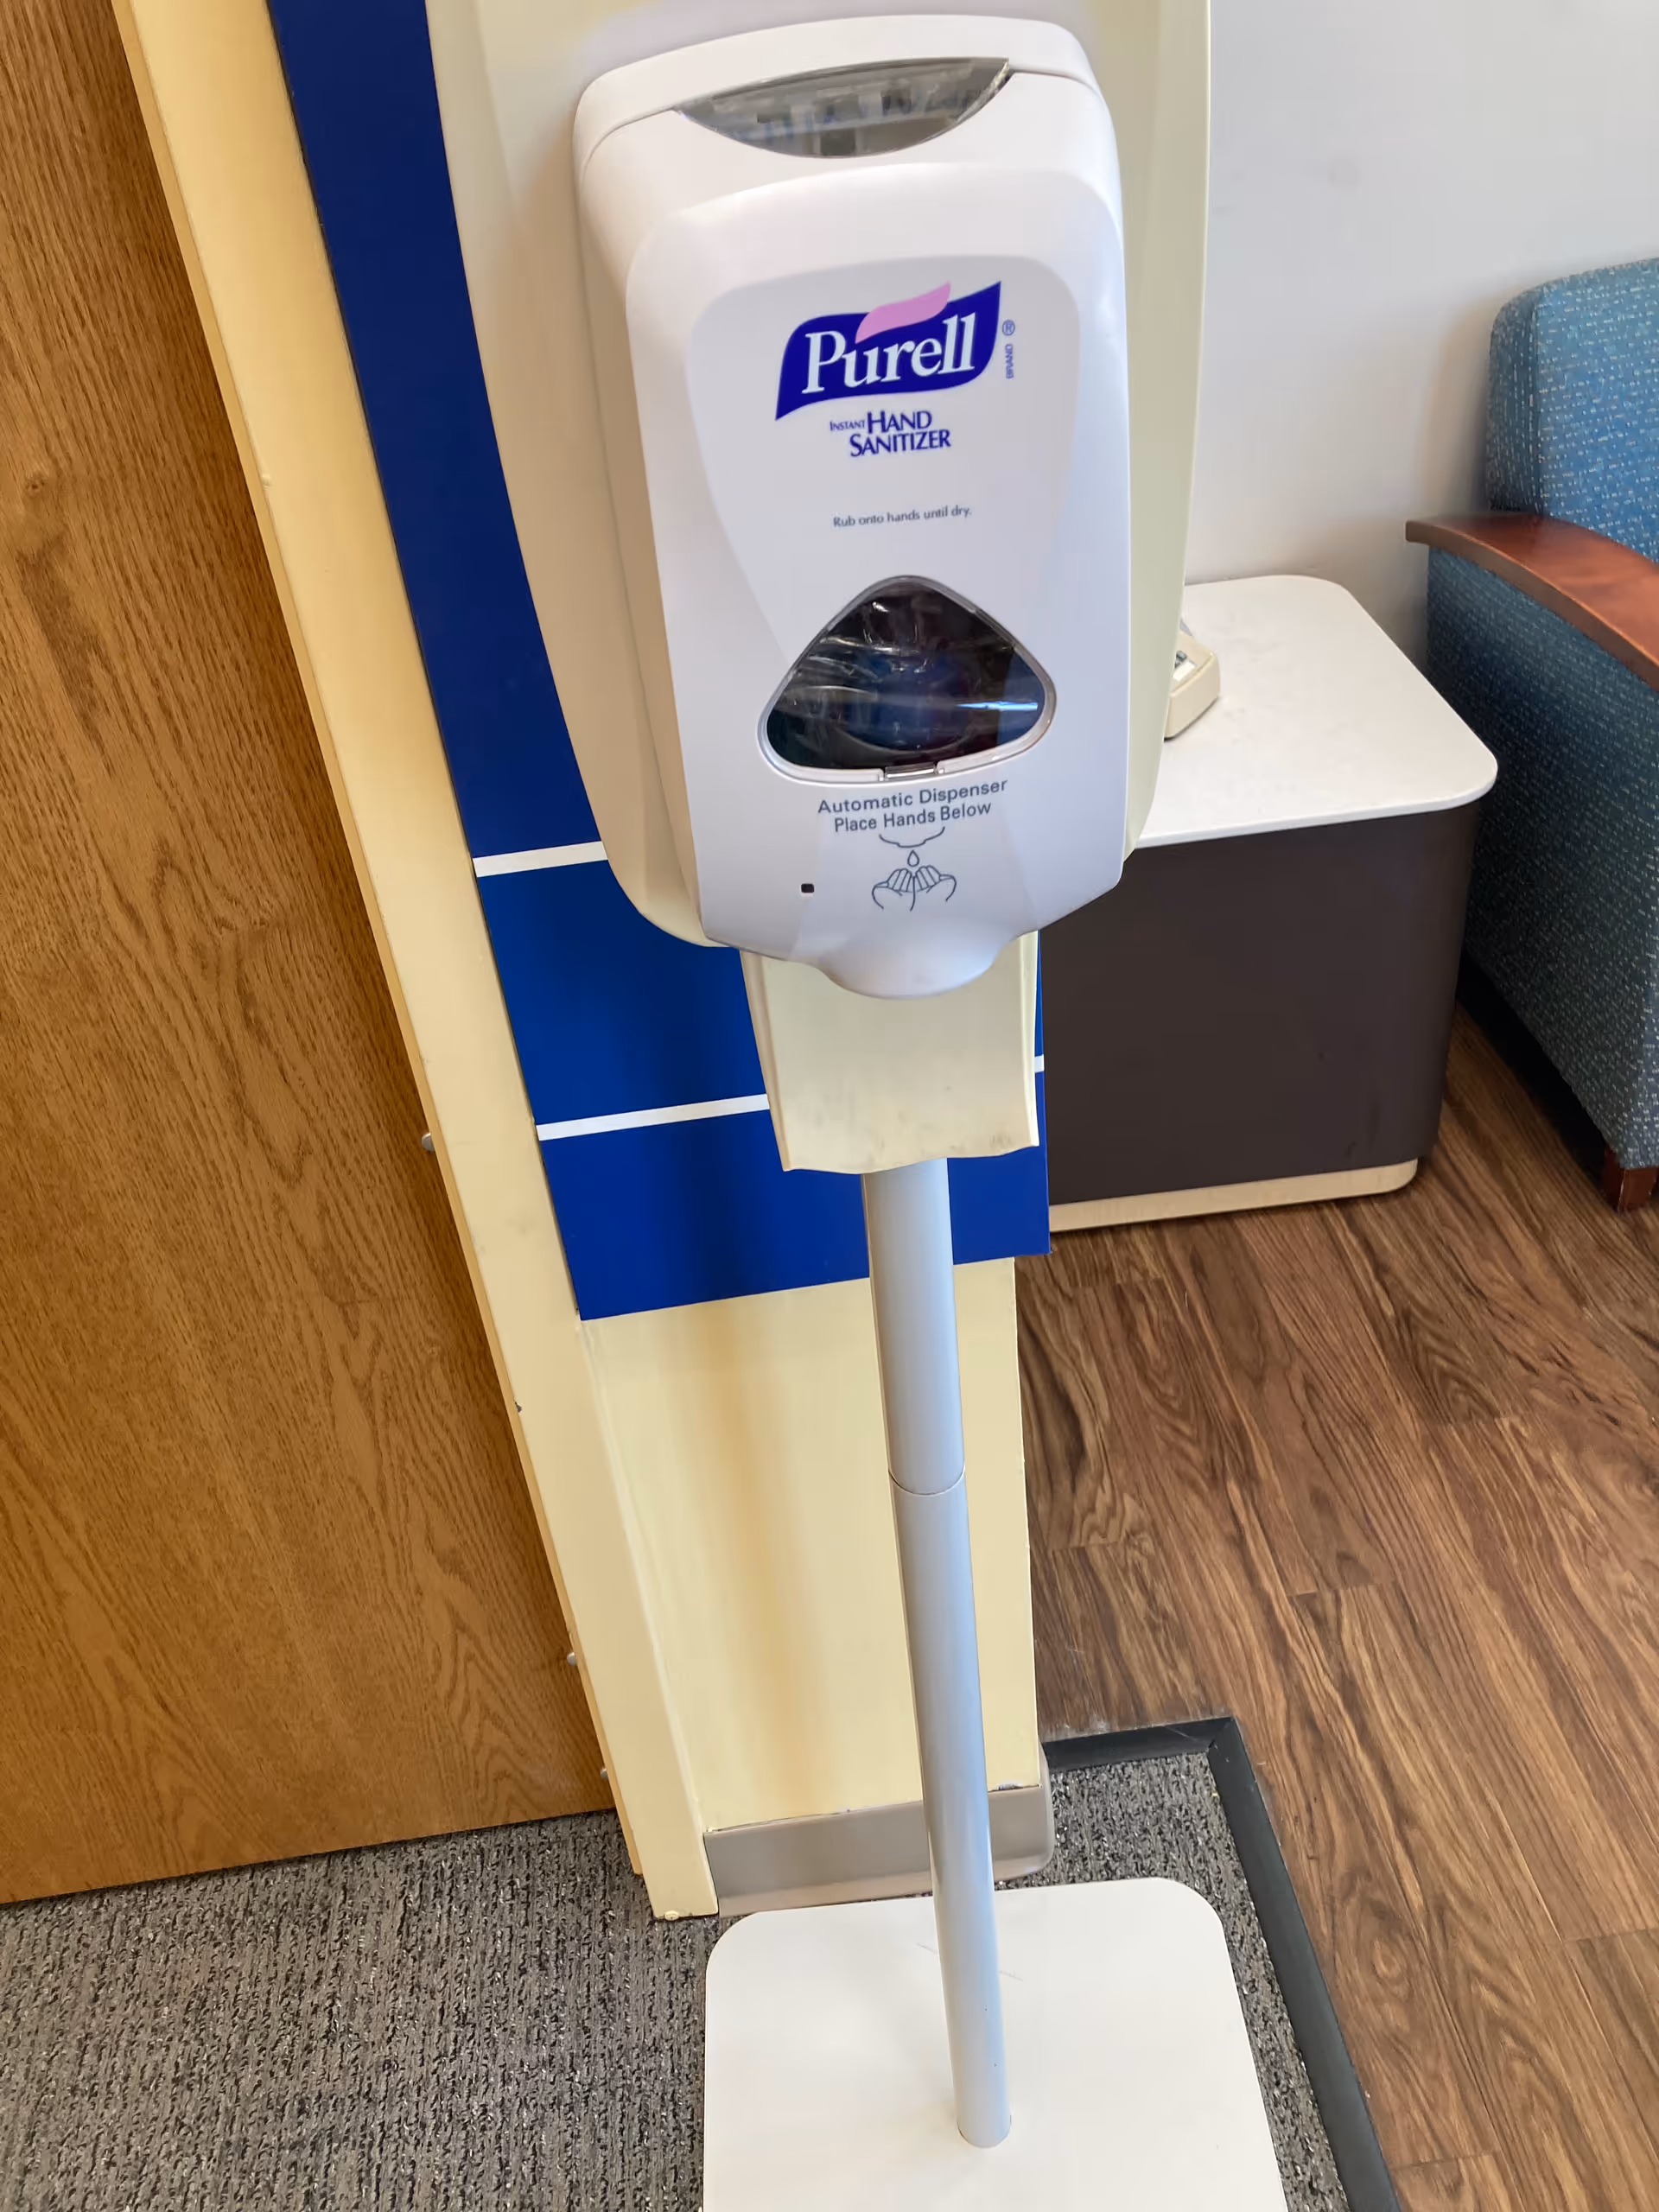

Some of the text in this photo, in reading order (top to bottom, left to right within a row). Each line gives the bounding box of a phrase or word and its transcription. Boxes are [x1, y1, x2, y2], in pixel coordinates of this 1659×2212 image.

[801, 312, 976, 394] Purell
[1004, 343, 1014, 378] BRAND
[830, 410, 932, 434] INSTANT HAND
[849, 429, 951, 457] SANITIZER
[833, 504, 972, 527] Rub onto hands until dry.
[817, 779, 1008, 814] Automatic Dispenser
[834, 802, 992, 832] Place Hands Below
